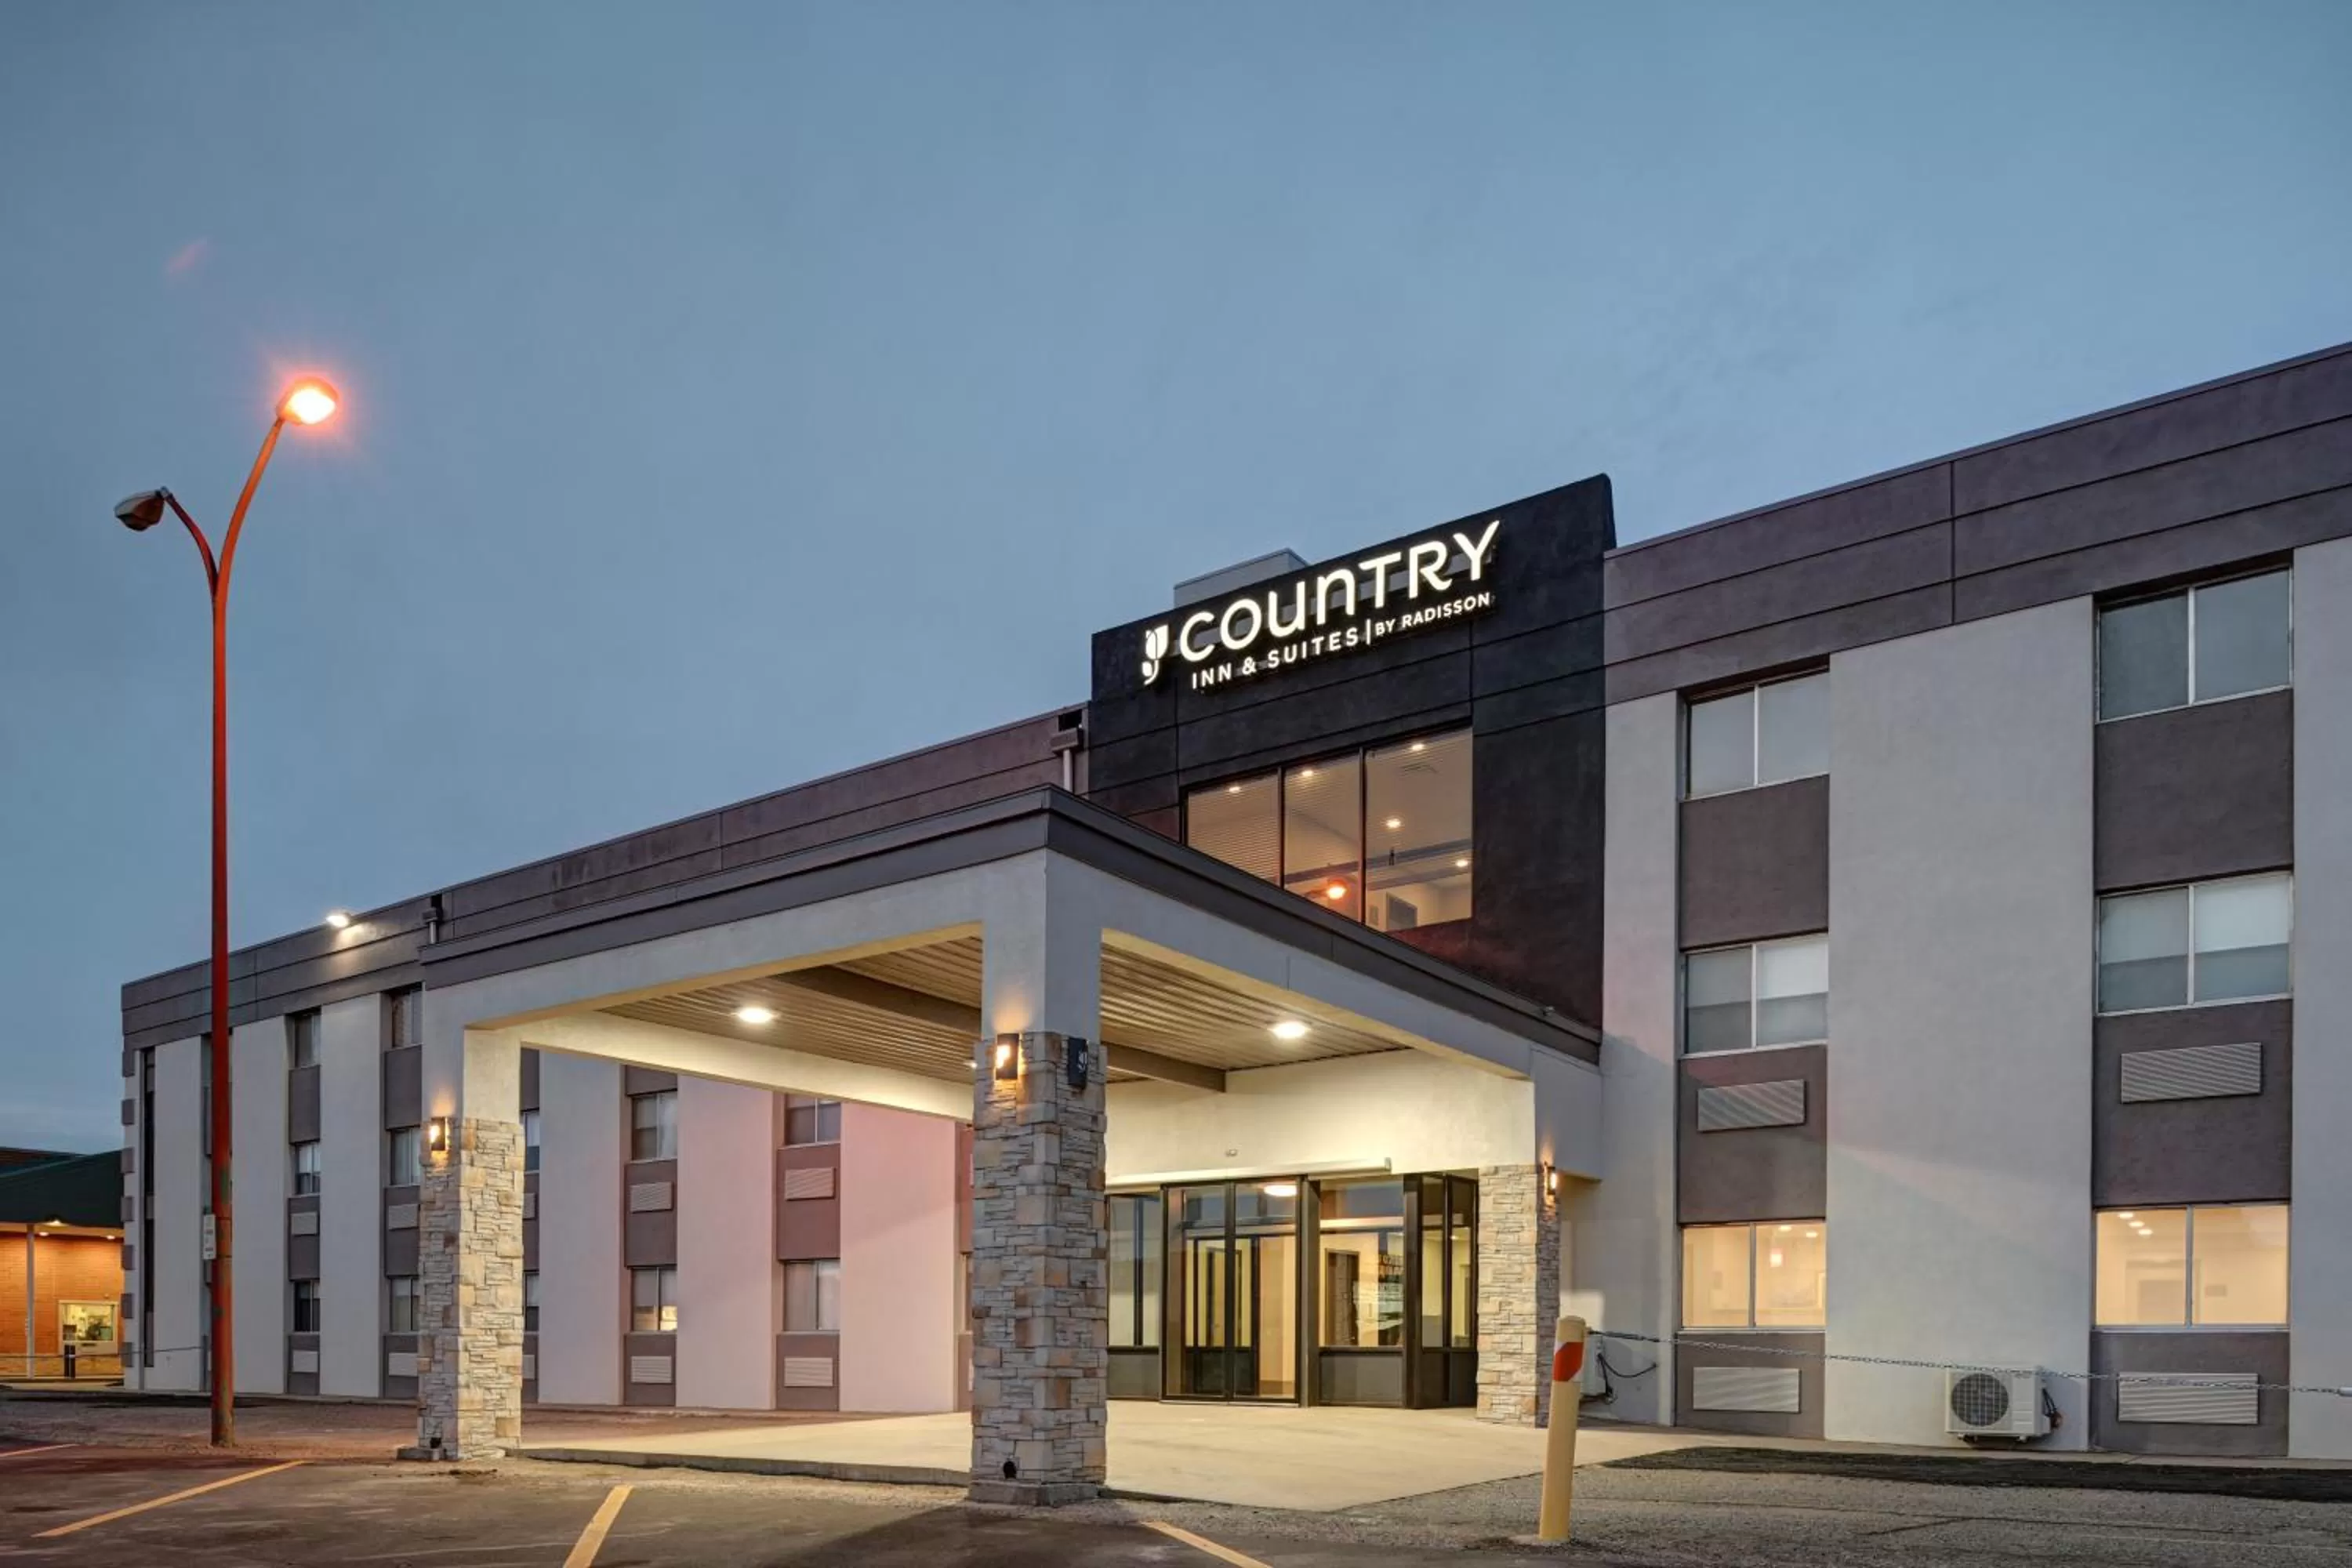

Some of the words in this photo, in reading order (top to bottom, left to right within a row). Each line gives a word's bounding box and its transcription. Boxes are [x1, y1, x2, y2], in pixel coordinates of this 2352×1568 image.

[1179, 520, 1501, 662] COUNTRY
[1191, 662, 1232, 690] INN
[1241, 656, 1258, 675] &
[1267, 627, 1359, 669] SUITES
[1374, 619, 1396, 637] BY
[1401, 592, 1490, 628] RADISSON
